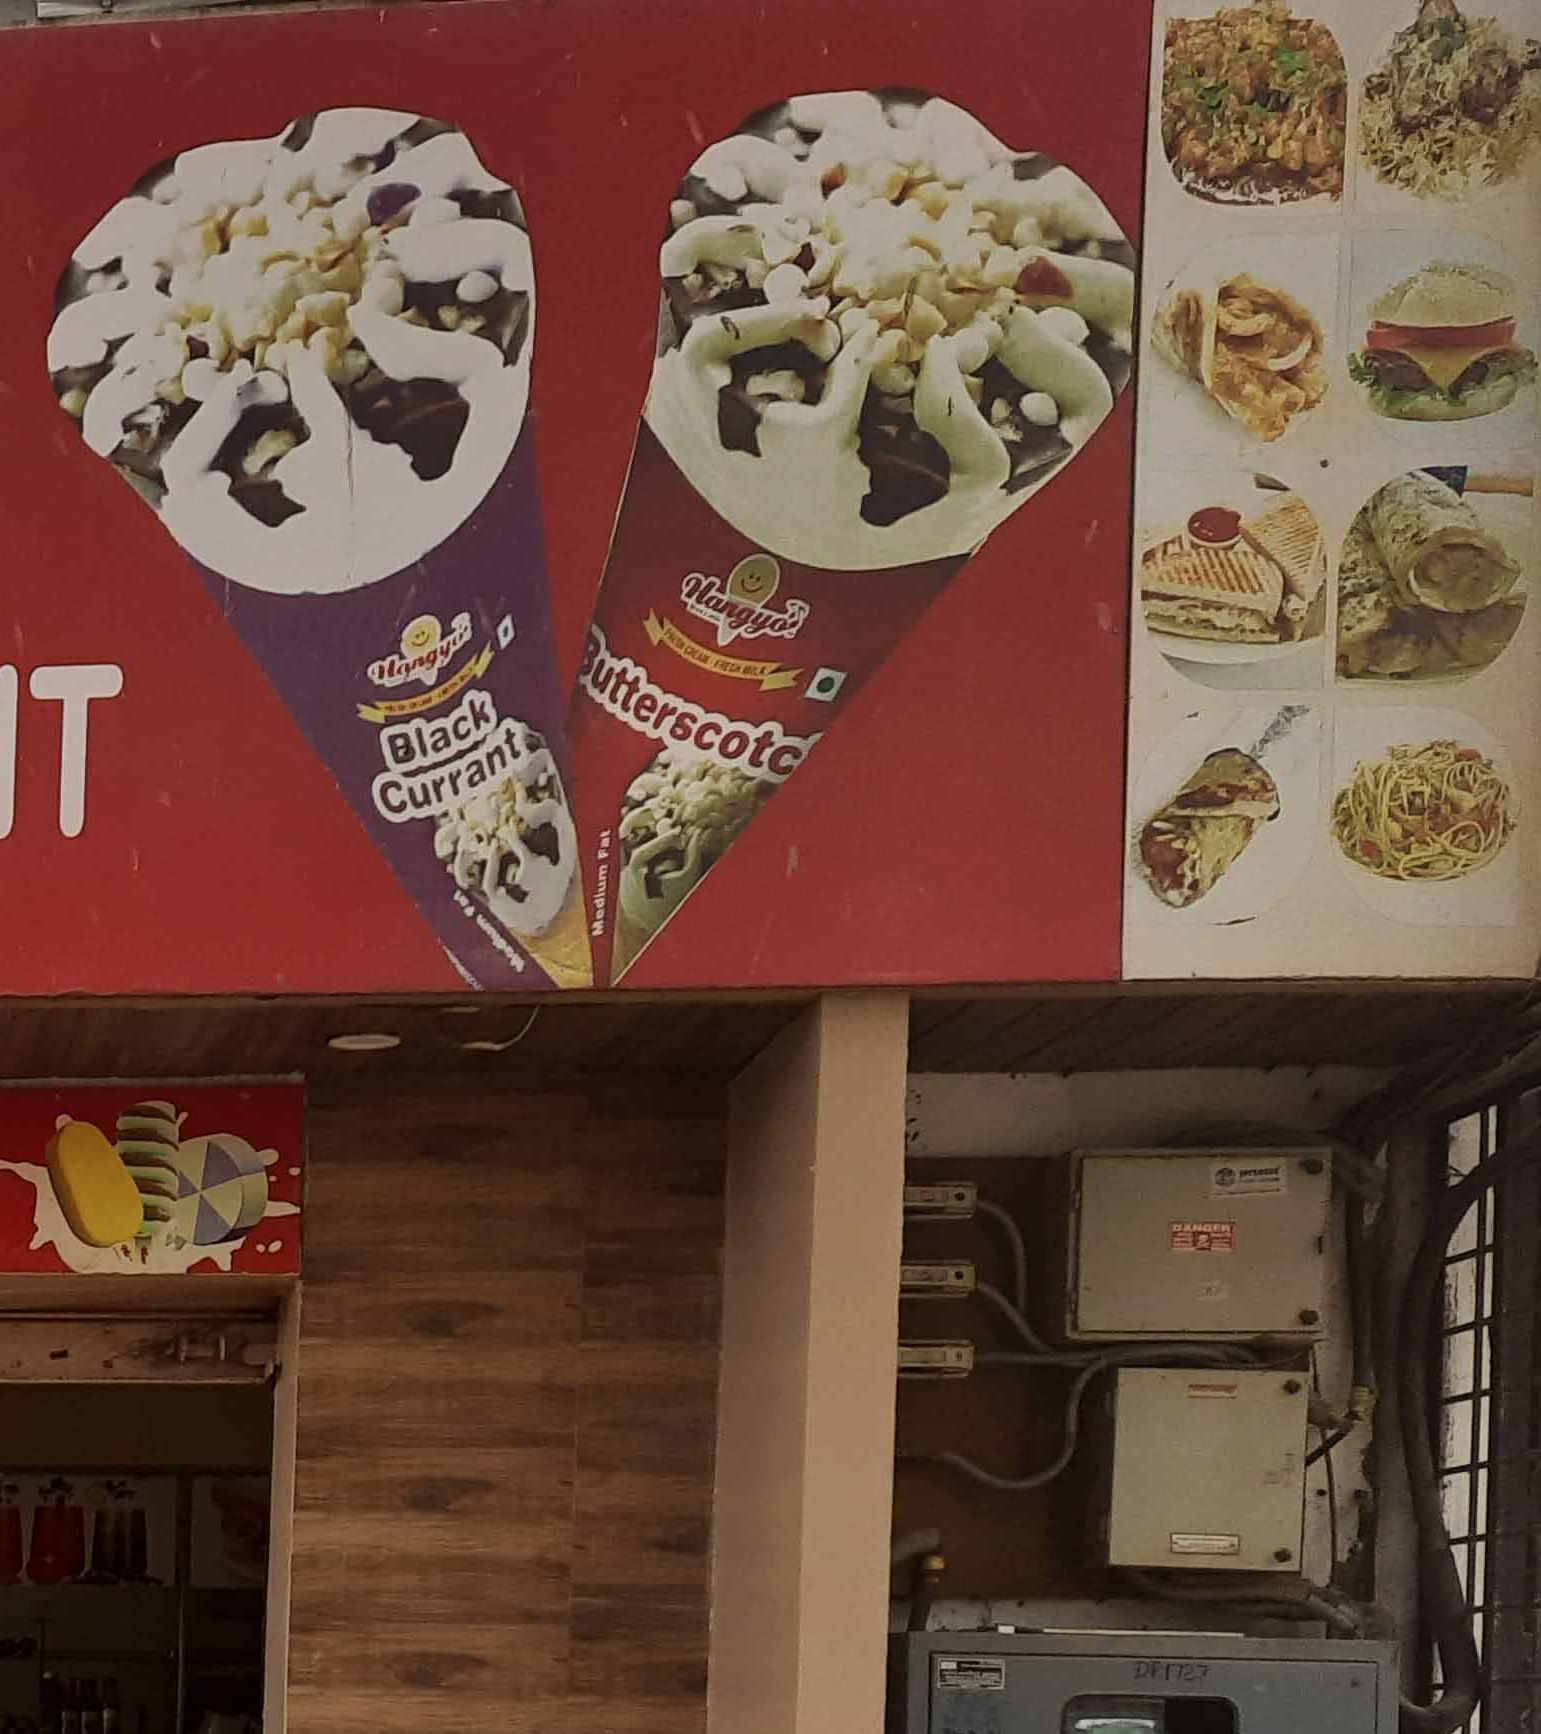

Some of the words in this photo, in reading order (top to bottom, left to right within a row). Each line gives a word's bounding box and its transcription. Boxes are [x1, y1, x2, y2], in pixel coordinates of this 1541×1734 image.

[386, 699, 491, 765] Black
[379, 727, 522, 814] Currant
[597, 829, 614, 860] Fat
[591, 864, 609, 937] Medium
